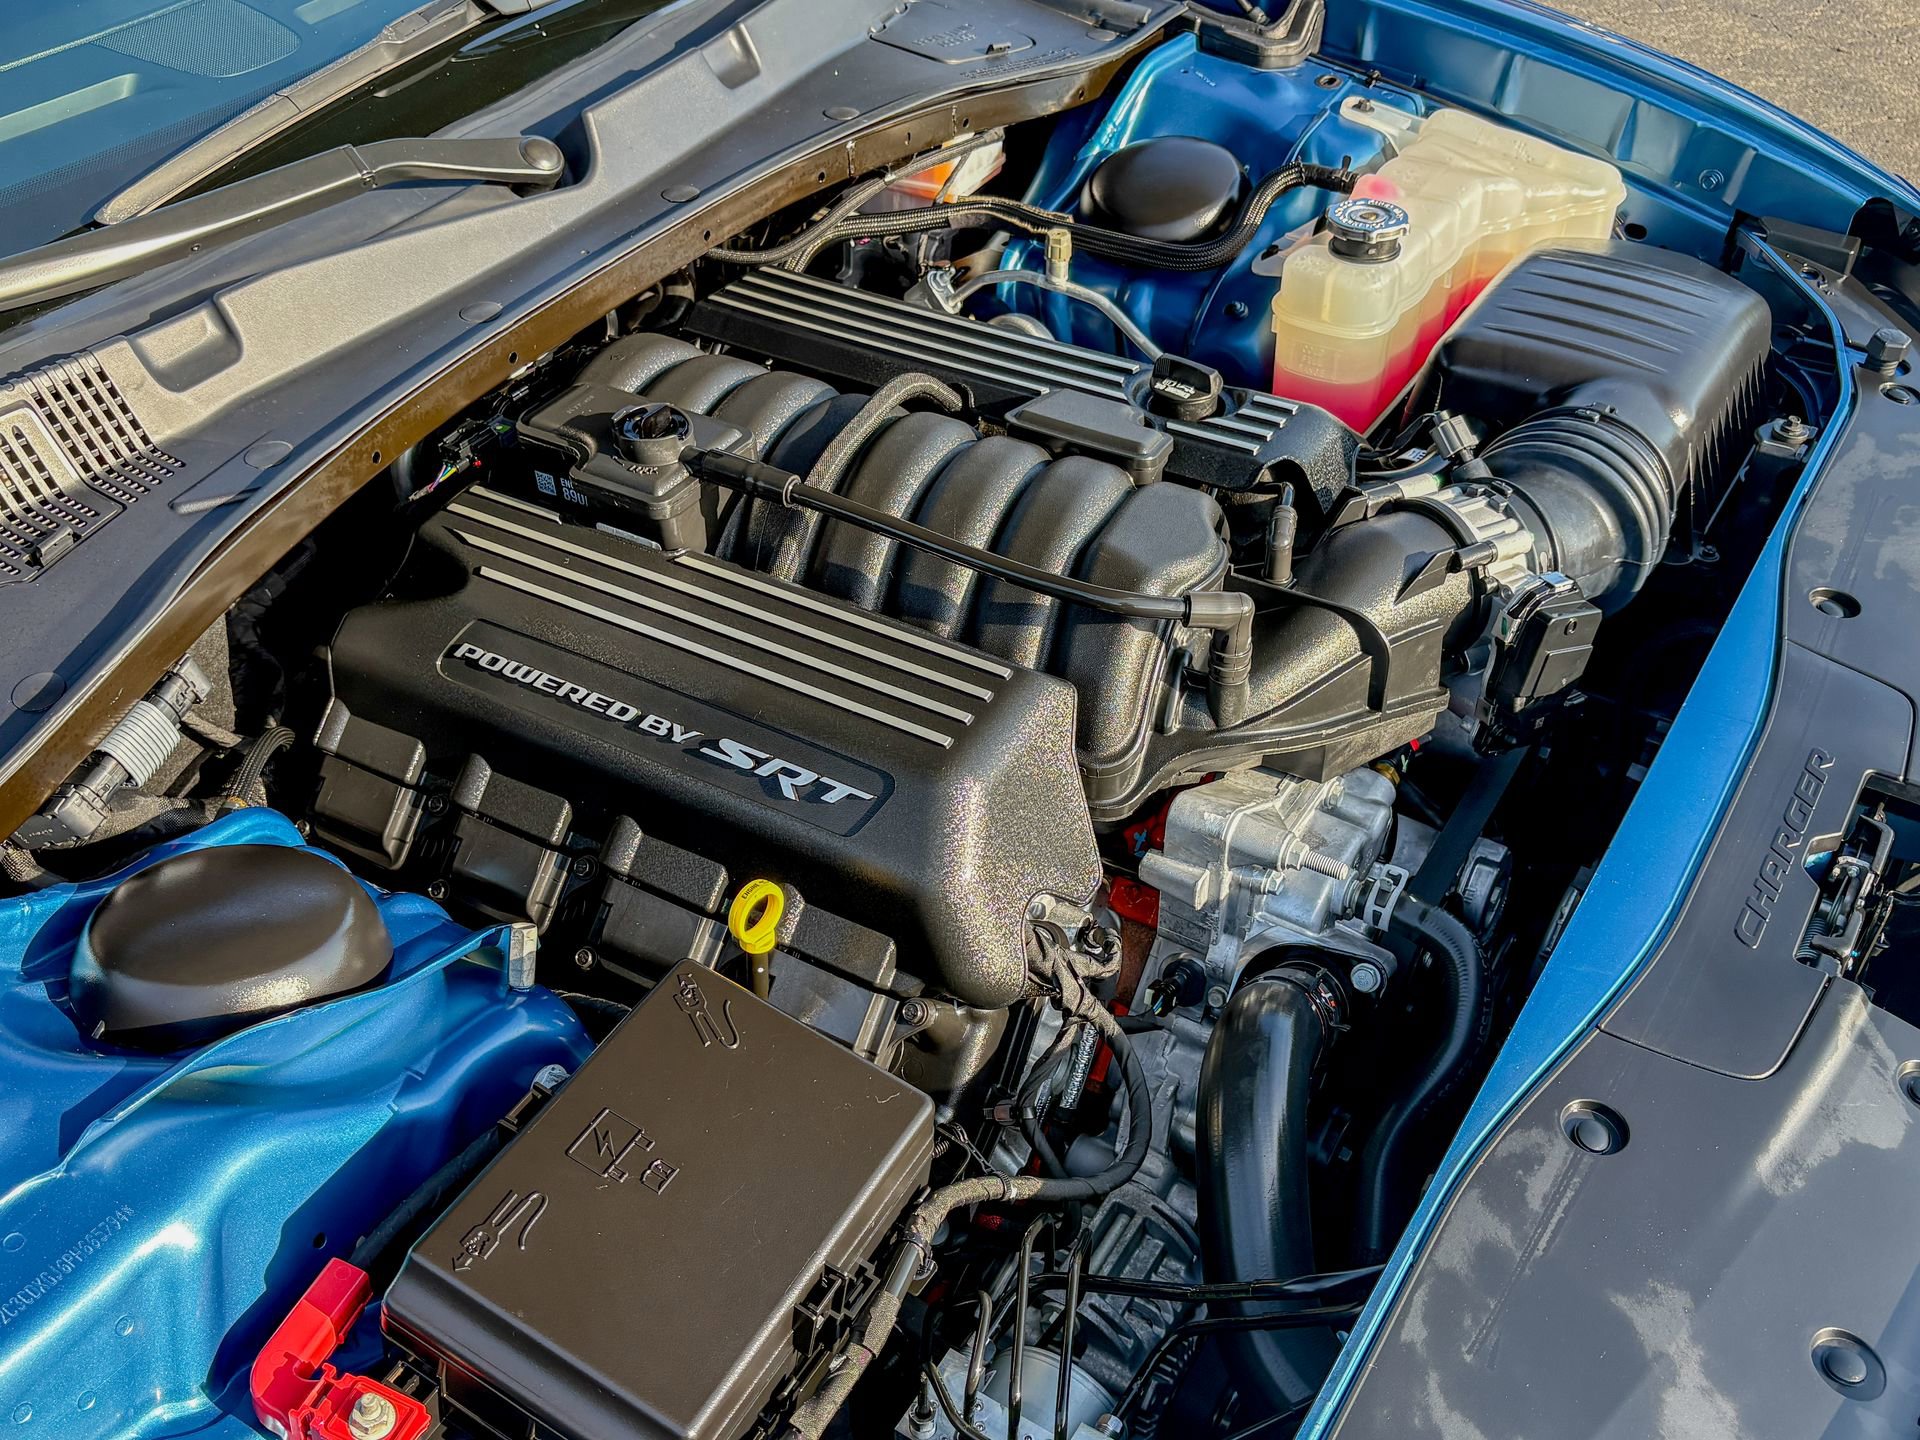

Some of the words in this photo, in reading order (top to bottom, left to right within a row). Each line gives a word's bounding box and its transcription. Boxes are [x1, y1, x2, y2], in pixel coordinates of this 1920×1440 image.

[453, 642, 642, 722] POWERED
[638, 713, 705, 744] BY
[699, 737, 878, 804] SRT
[1734, 747, 1836, 949] CHARGER
